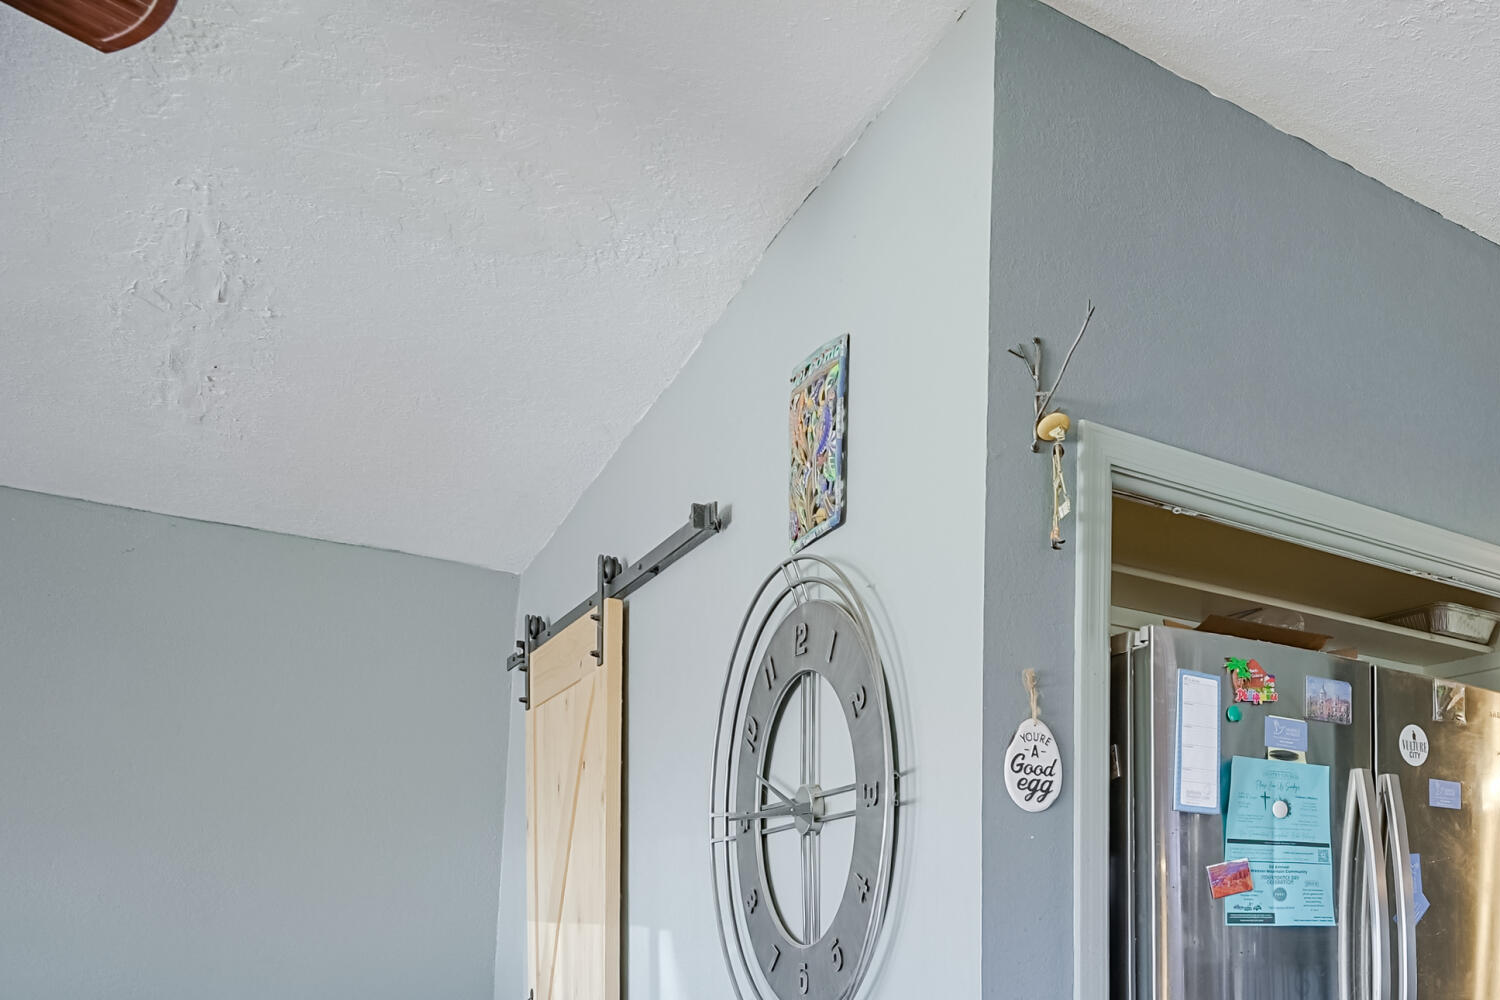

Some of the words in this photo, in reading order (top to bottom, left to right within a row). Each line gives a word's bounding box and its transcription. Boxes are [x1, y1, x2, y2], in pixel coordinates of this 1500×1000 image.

[1030, 744, 1040, 758] A
[1402, 739, 1427, 754] VULTURE
[1409, 751, 1421, 759] CITY
[1010, 753, 1057, 777] Good
[1016, 777, 1054, 803] egg
